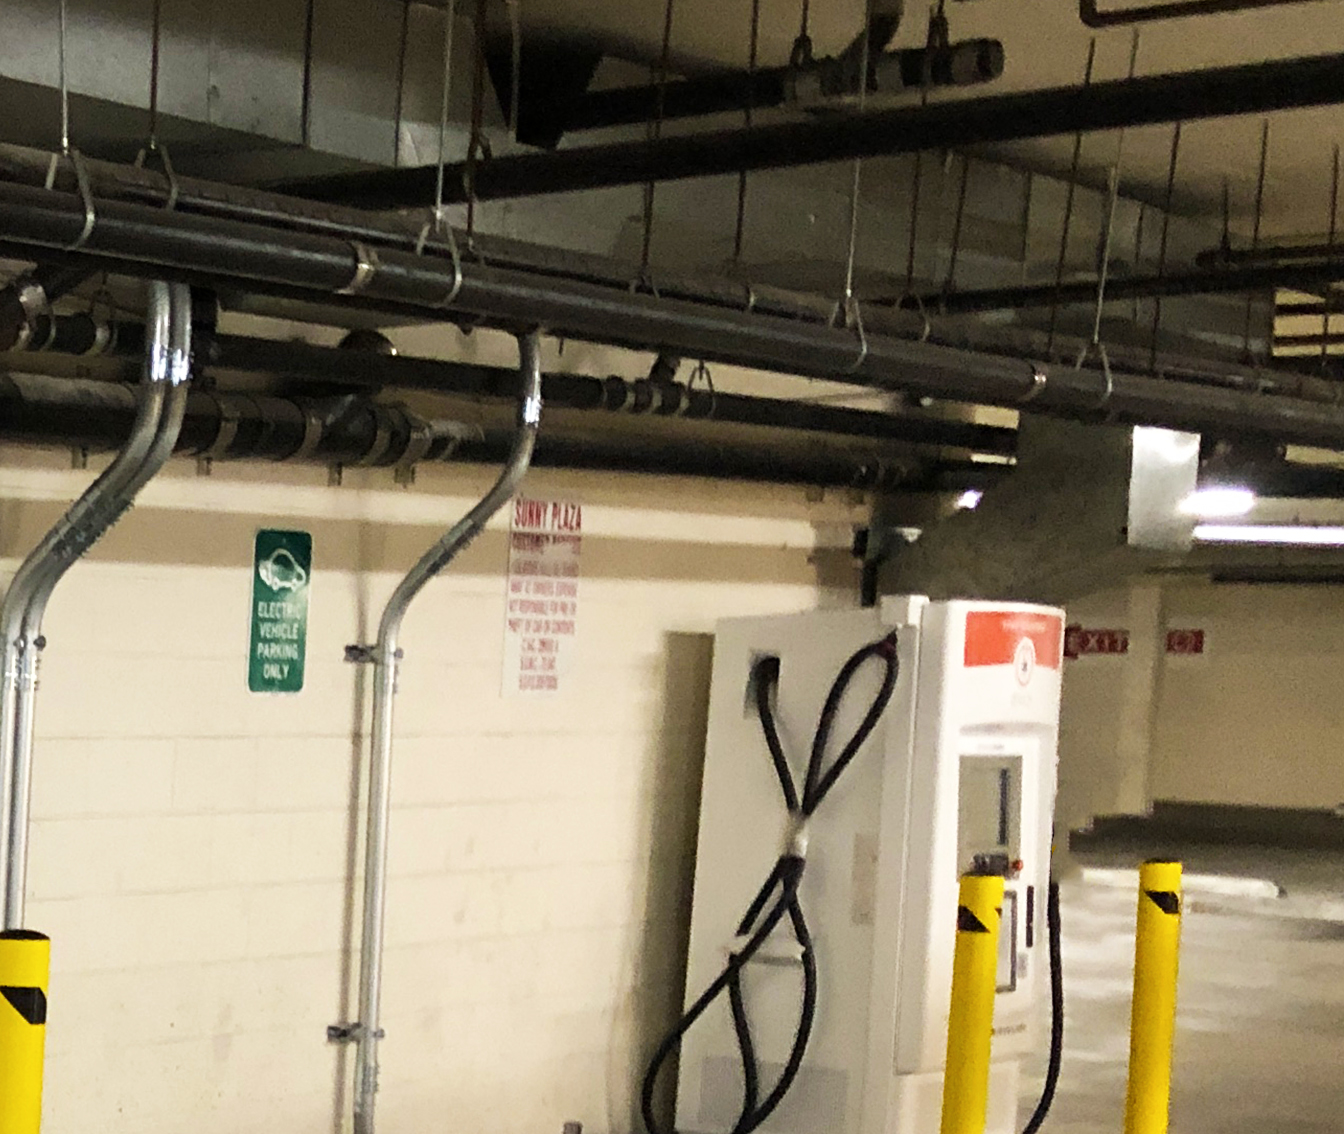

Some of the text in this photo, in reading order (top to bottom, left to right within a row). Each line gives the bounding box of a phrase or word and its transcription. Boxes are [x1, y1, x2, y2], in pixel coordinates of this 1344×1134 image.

[551, 501, 582, 531] PLAZA
[257, 601, 301, 620] ELECTRIC
[259, 621, 299, 640] VEHICLE
[257, 642, 299, 660] PARKING
[262, 664, 290, 680] ONLY
